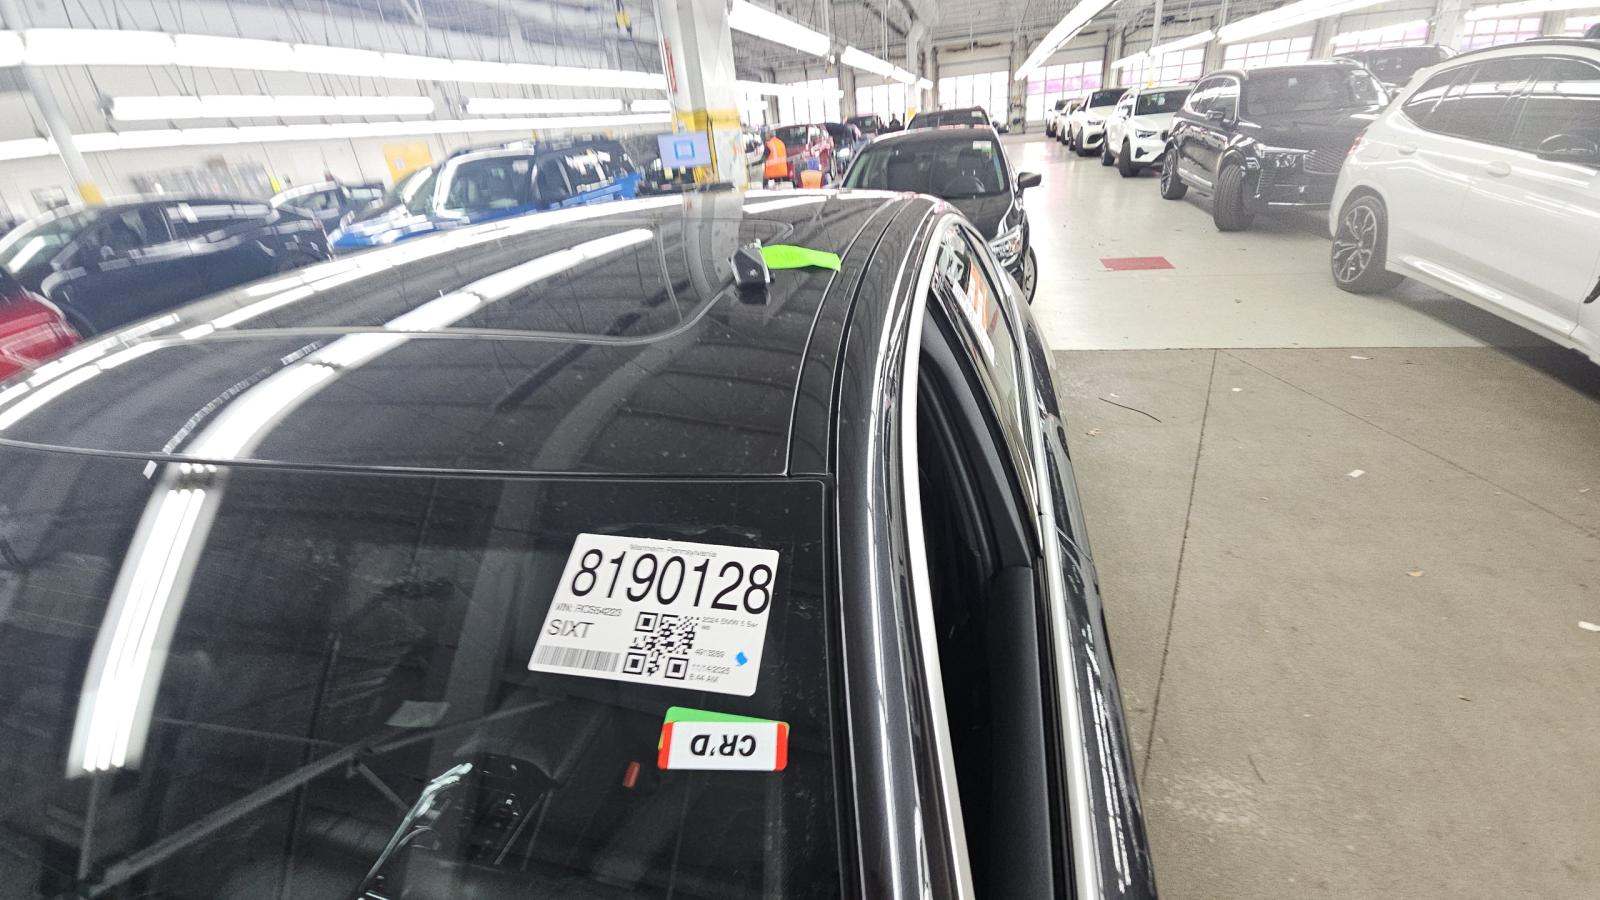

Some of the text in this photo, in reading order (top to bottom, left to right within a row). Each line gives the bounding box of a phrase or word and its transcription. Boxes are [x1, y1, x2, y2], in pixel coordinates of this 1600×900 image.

[571, 548, 773, 615] 8190128
[547, 618, 595, 638] SIXT
[690, 734, 756, 756] CR'D
